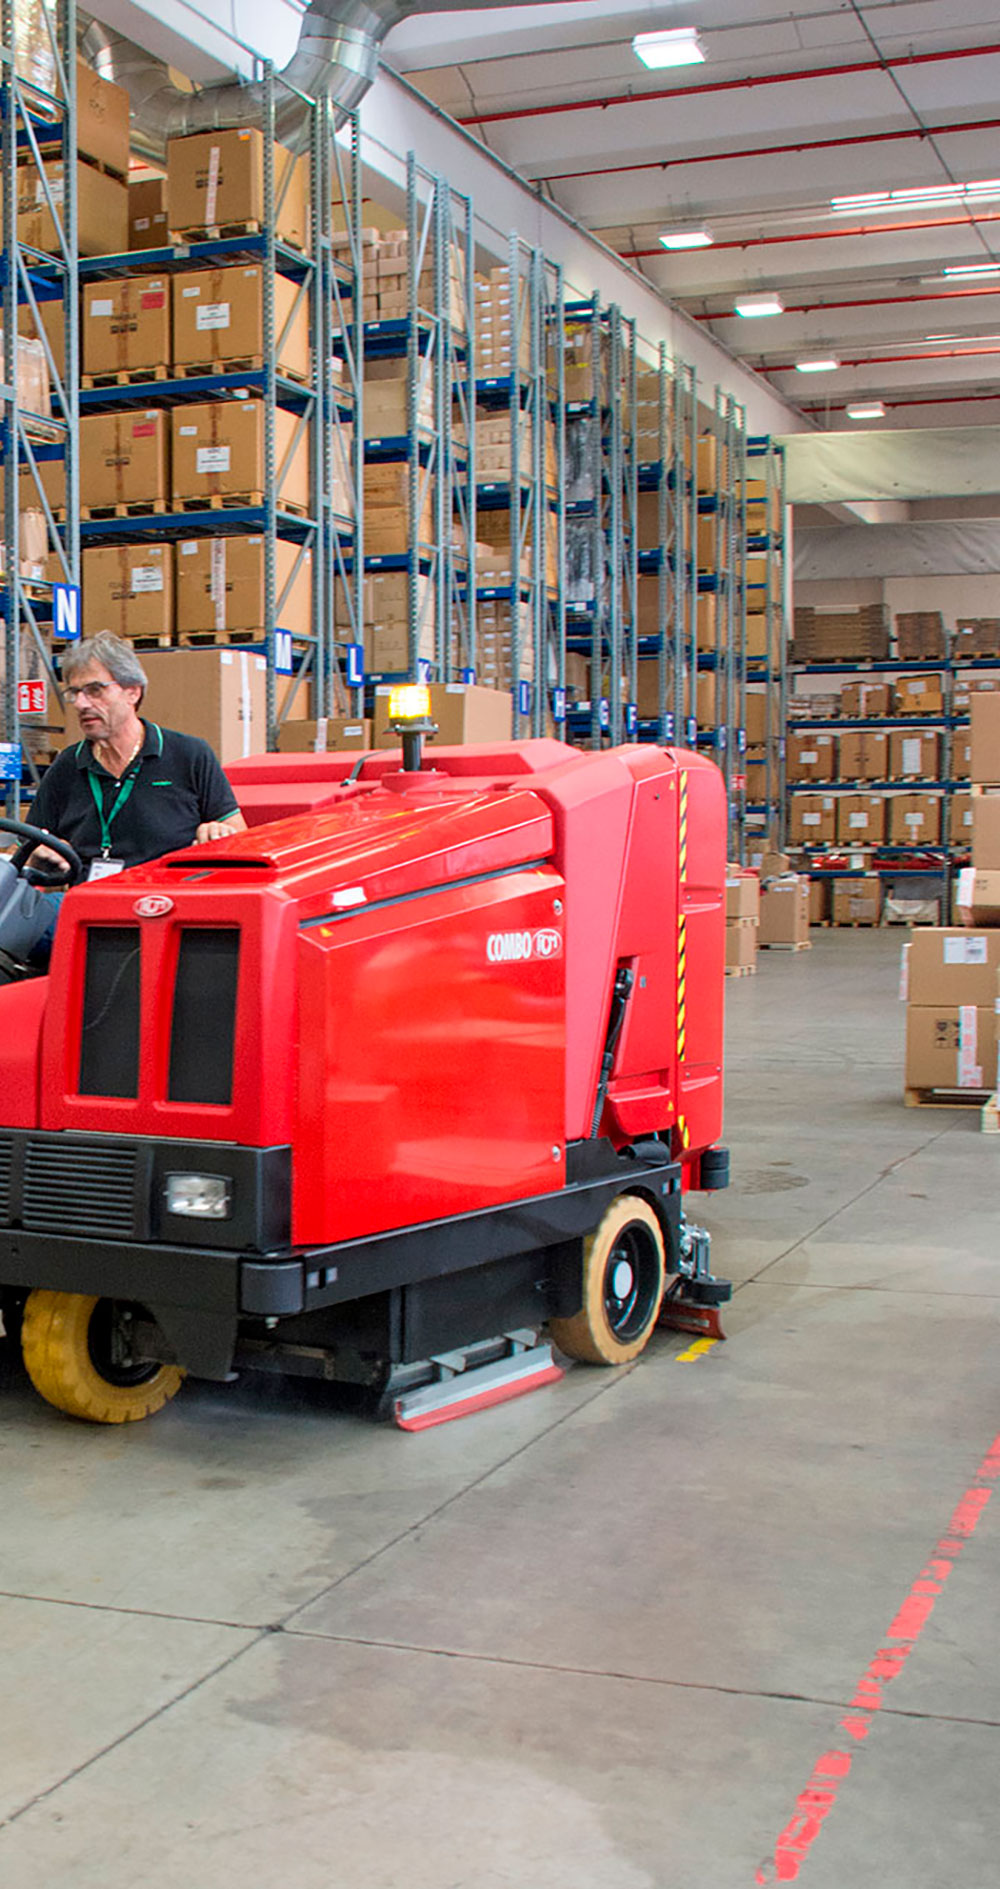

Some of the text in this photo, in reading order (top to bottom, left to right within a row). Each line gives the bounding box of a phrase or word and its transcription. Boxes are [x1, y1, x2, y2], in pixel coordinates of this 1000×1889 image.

[56, 588, 77, 634] N
[275, 632, 292, 669] M
[350, 647, 363, 682] L
[554, 690, 566, 718] H
[629, 705, 637, 731] F
[486, 931, 532, 962] COMBO
